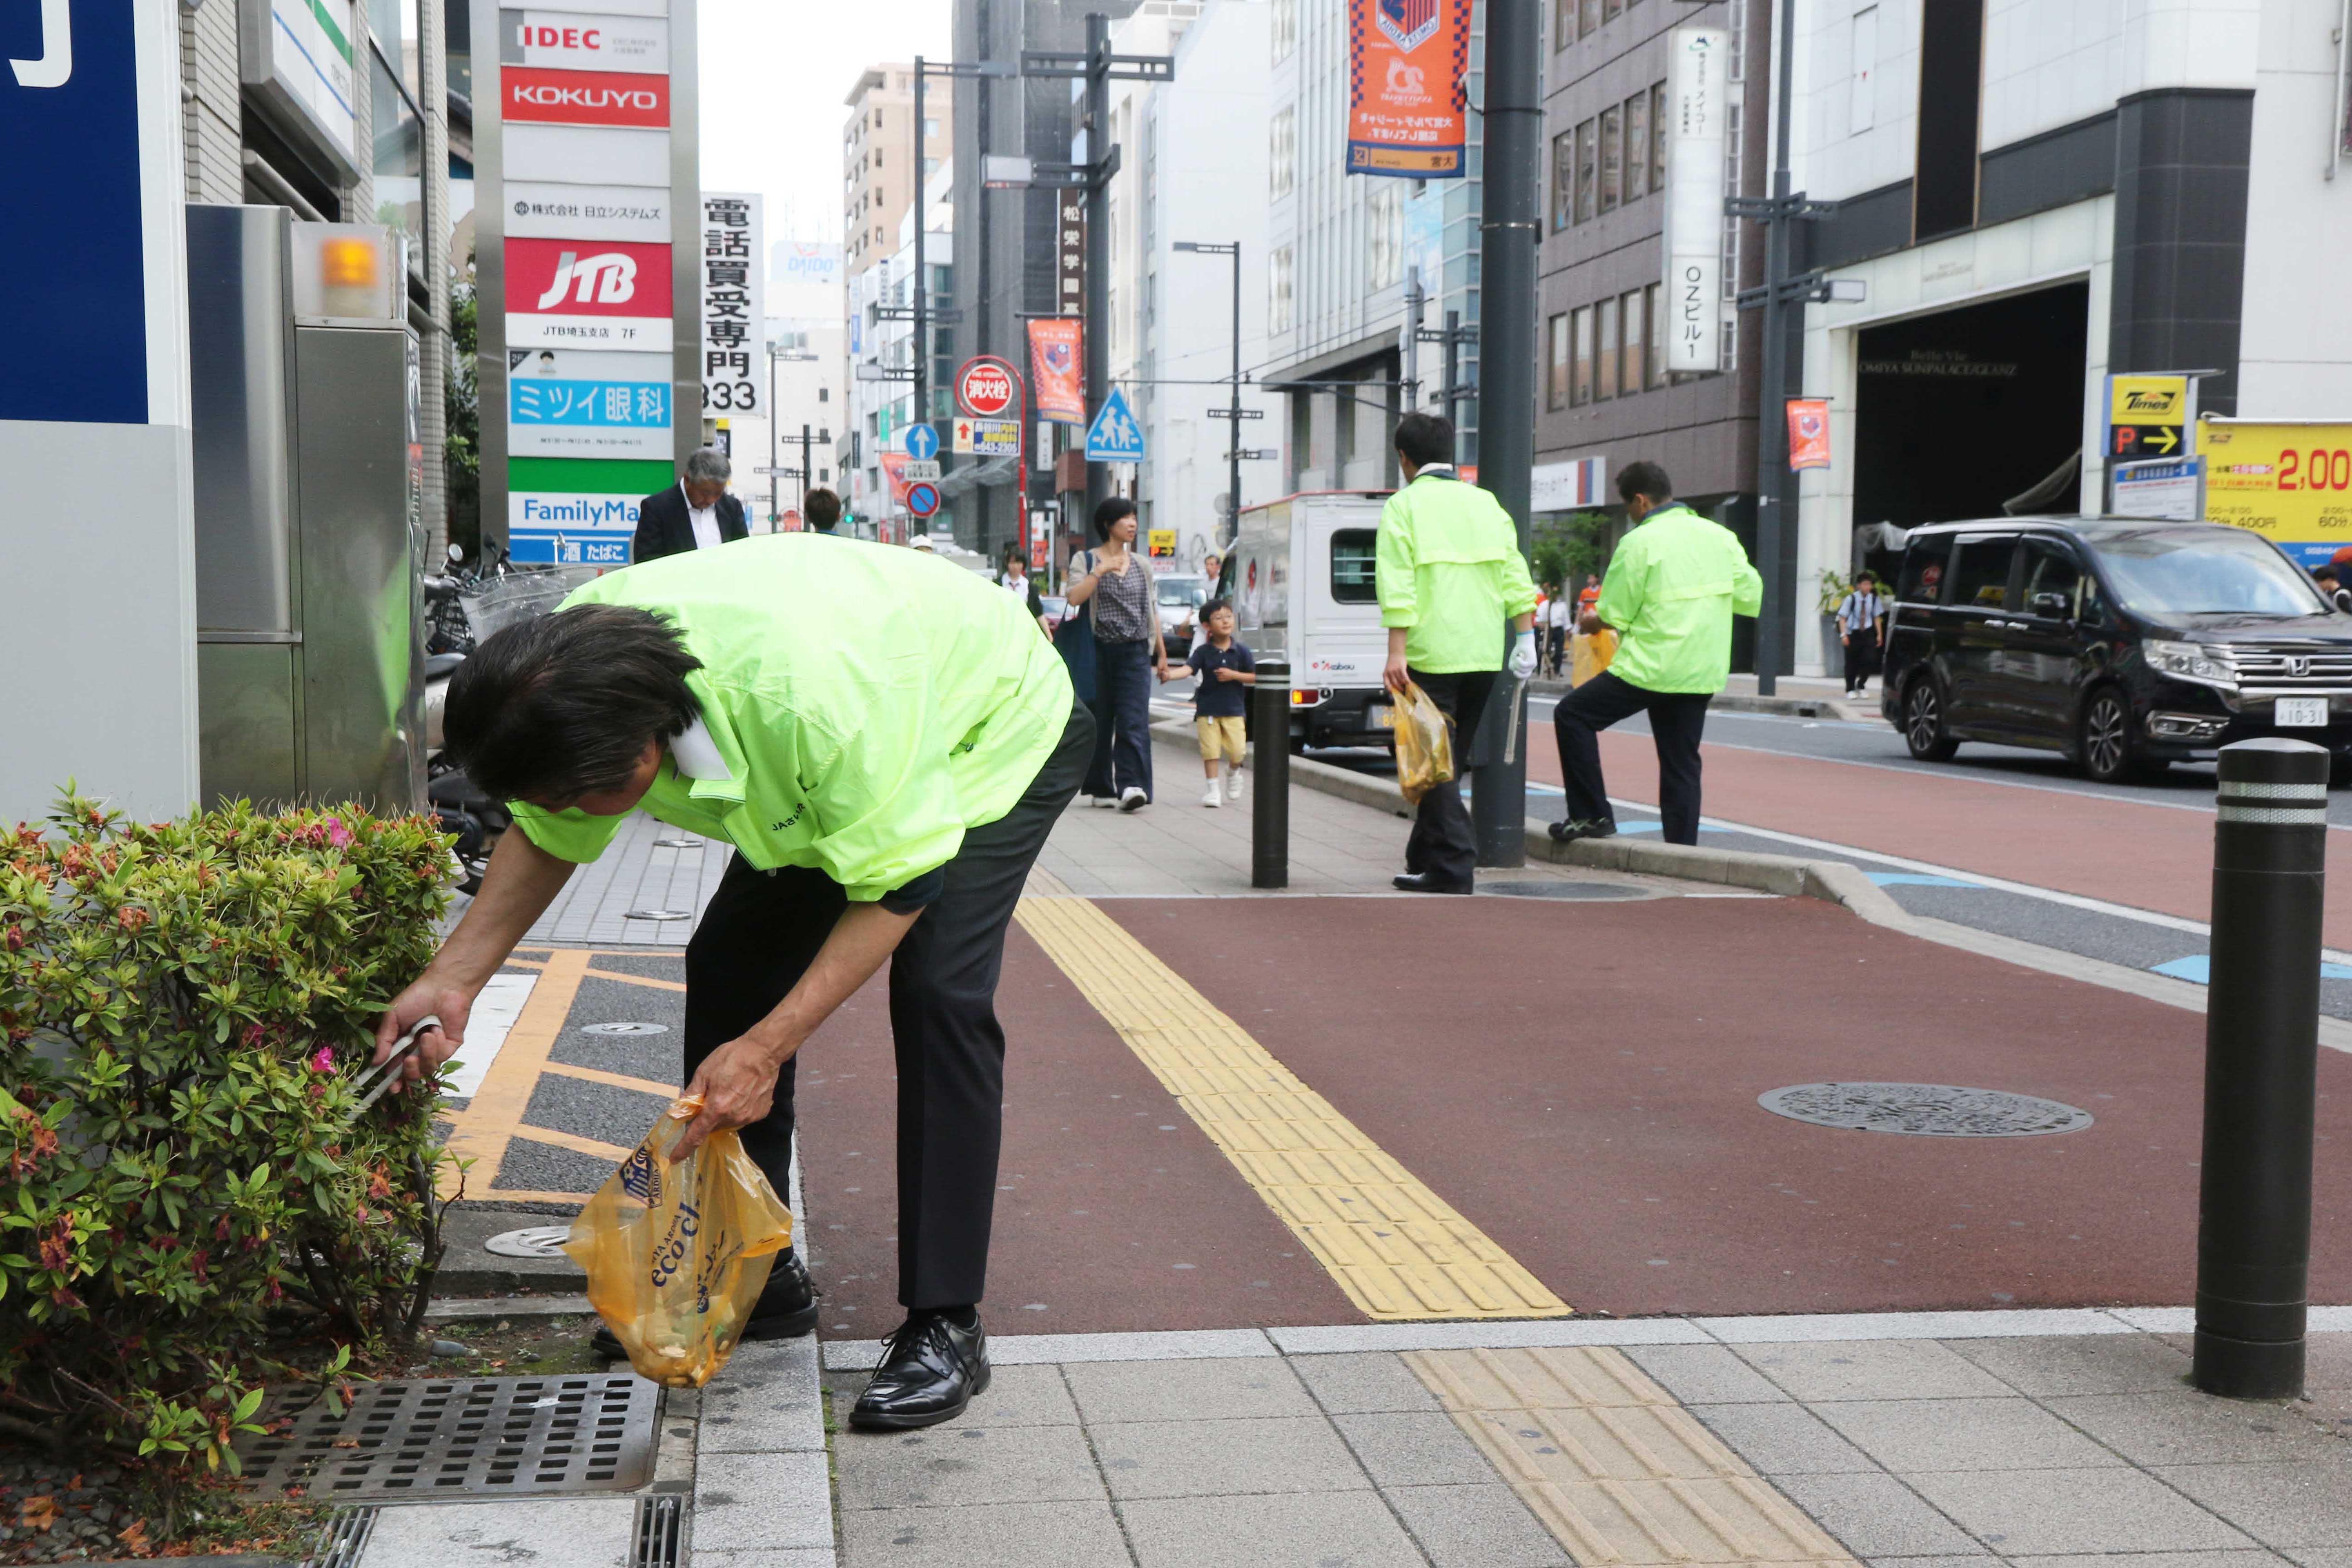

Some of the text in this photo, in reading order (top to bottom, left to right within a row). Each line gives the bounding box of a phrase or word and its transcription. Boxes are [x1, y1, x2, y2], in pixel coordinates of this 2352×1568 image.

[524, 25, 600, 49] IDEC
[514, 85, 657, 109] KOKUYO
[532, 203, 661, 220] 株式会社 日立システムズ
[537, 252, 637, 310] JTB
[704, 198, 751, 377] 電話買受専門
[543, 326, 637, 339] JTB埼玉支店 7F
[969, 379, 1008, 399] 消火栓
[2126, 392, 2176, 410] Times
[518, 385, 664, 423] ミツイ眼科
[2117, 427, 2136, 454] P
[524, 500, 639, 527] FamilyMa
[587, 544, 624, 561] たばこ
[773, 803, 806, 831] JAさいた
[652, 1240, 685, 1288] eco
